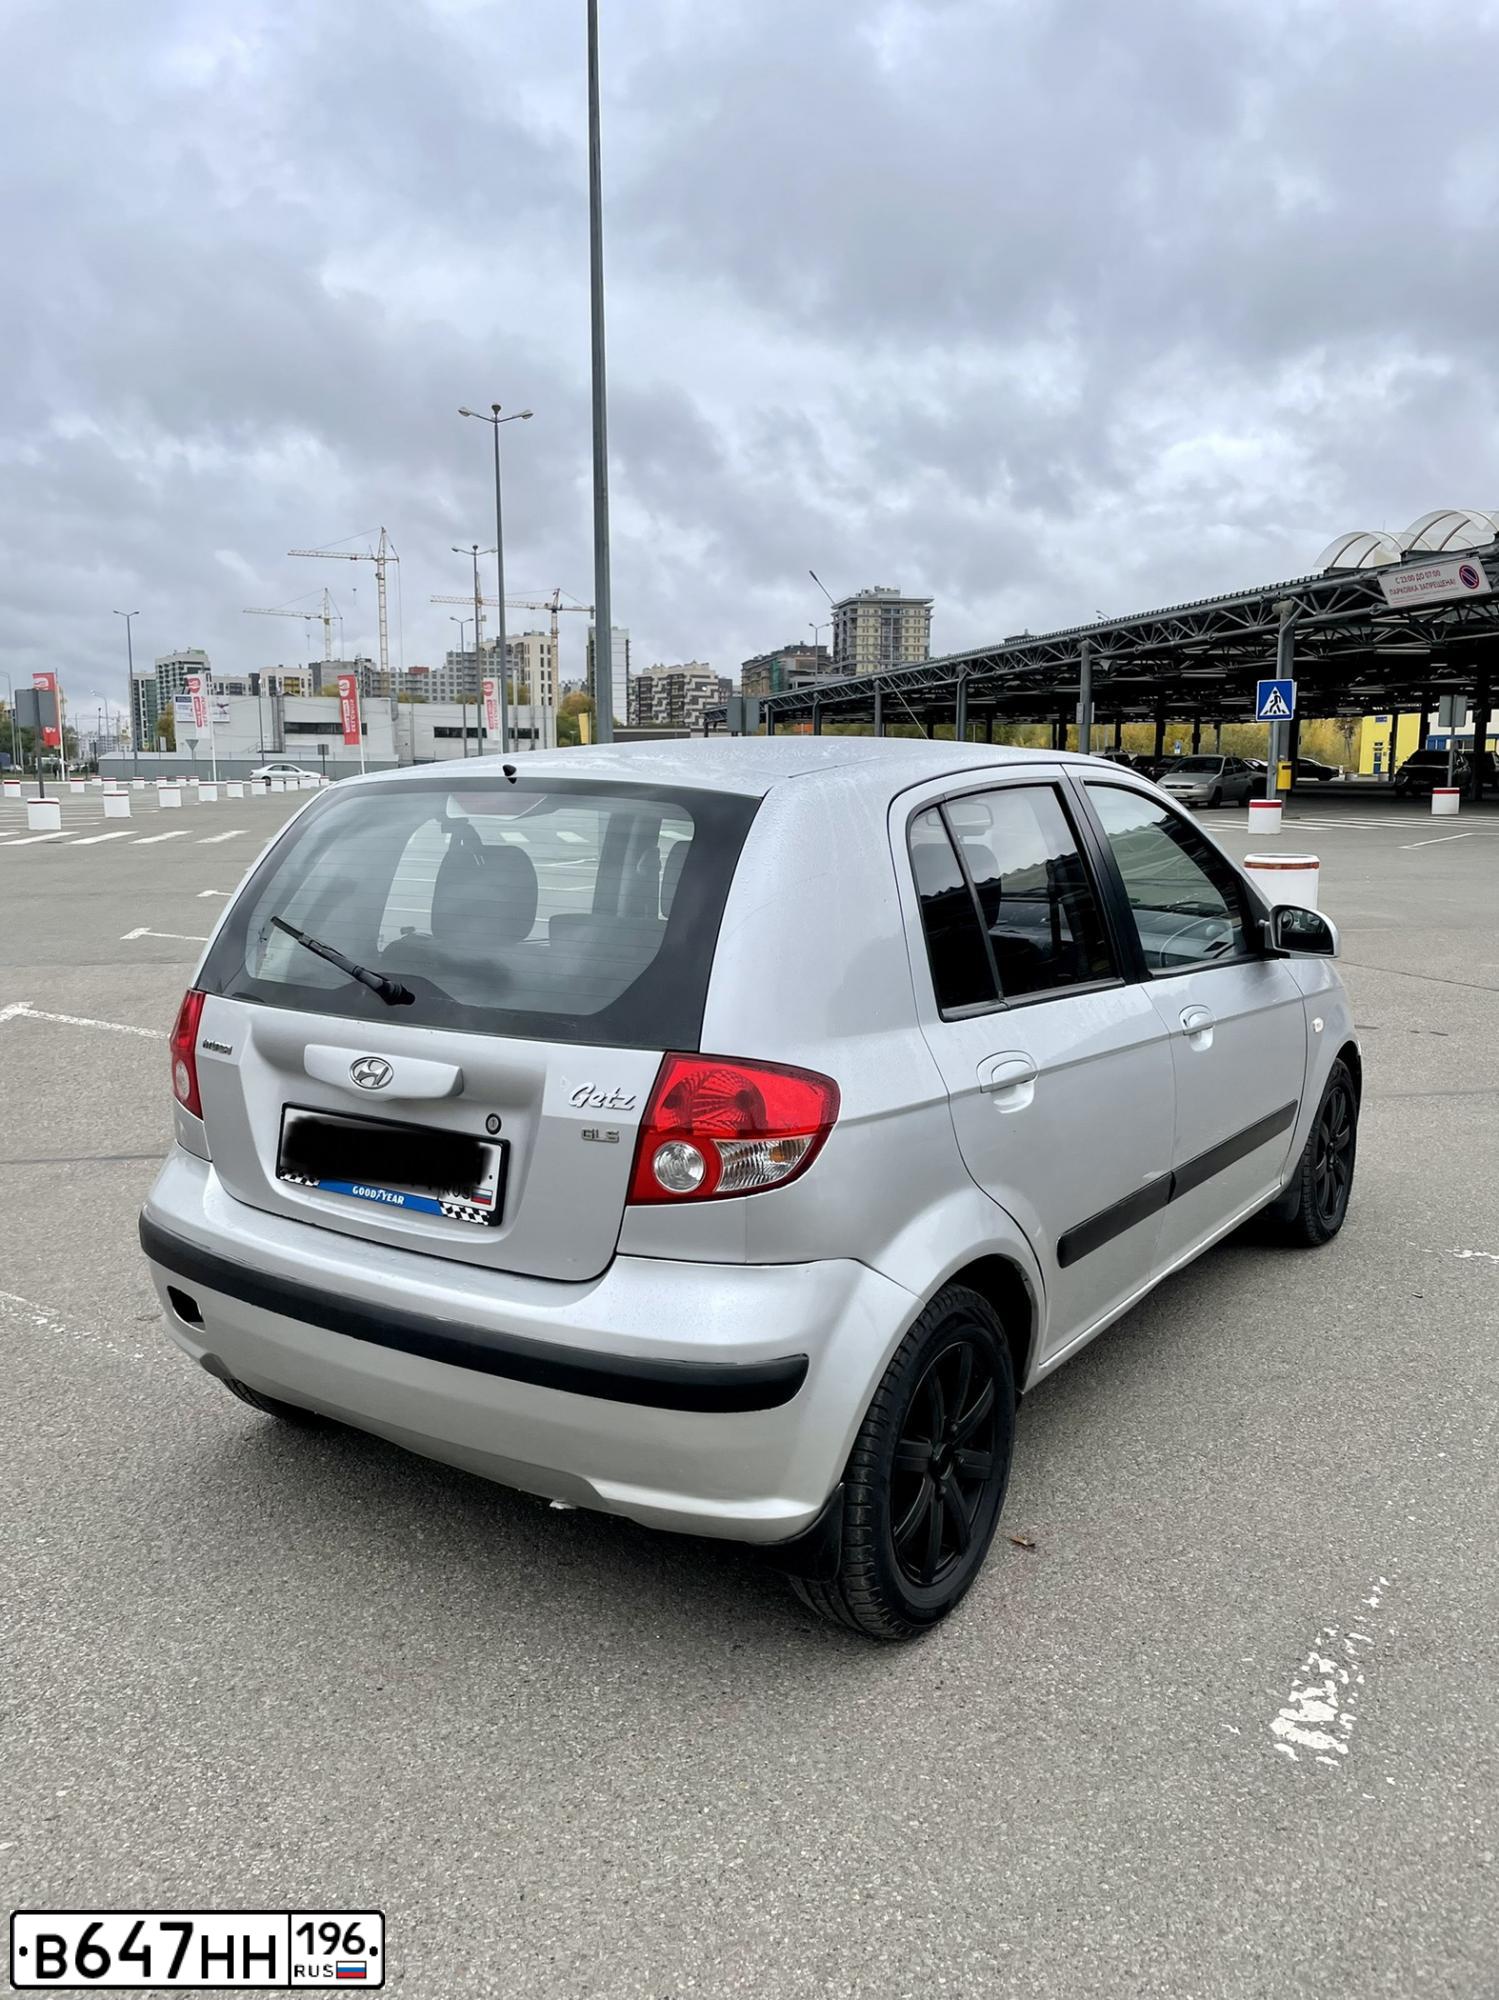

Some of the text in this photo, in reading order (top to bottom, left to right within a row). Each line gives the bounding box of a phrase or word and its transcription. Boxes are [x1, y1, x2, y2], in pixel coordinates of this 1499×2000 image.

[569, 1082, 636, 1111] Getz
[581, 1128, 620, 1144] GLS
[352, 1185, 405, 1206] GOODYEAR
